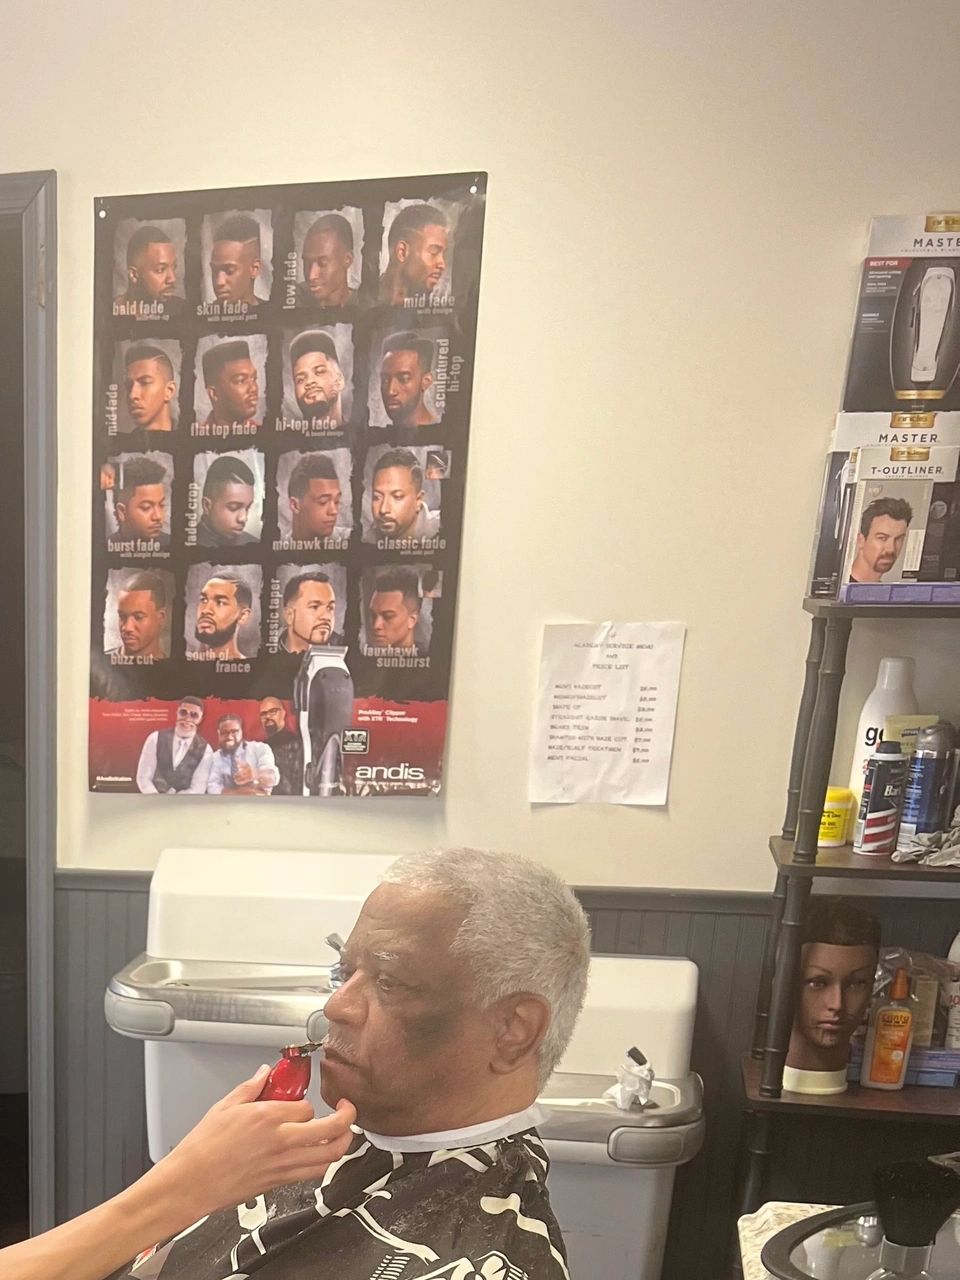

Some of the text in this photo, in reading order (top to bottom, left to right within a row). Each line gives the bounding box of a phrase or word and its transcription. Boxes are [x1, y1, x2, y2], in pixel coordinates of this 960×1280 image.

[913, 238, 960, 248] MASTE
[112, 300, 165, 316] bald fade
[196, 300, 249, 316] skin fade
[403, 293, 456, 309] mid fade
[435, 338, 450, 409] sculptured
[448, 355, 465, 393] hi-top
[212, 424, 230, 439] top
[232, 422, 258, 436] fade
[275, 416, 338, 434] hi-top fade
[878, 433, 938, 443] MASTER
[871, 465, 944, 475] T-OUTLINER
[185, 482, 202, 547] faded crop
[107, 538, 161, 553] burst fade
[272, 536, 349, 551] mohawk fade
[377, 535, 447, 550] classic fade
[265, 578, 283, 654] classic taper
[186, 648, 229, 662] south of
[363, 644, 419, 657] fauxhawk
[111, 653, 154, 665] buzz cut
[376, 656, 431, 668] sunburst
[215, 660, 251, 674] france
[355, 763, 424, 780] andis
